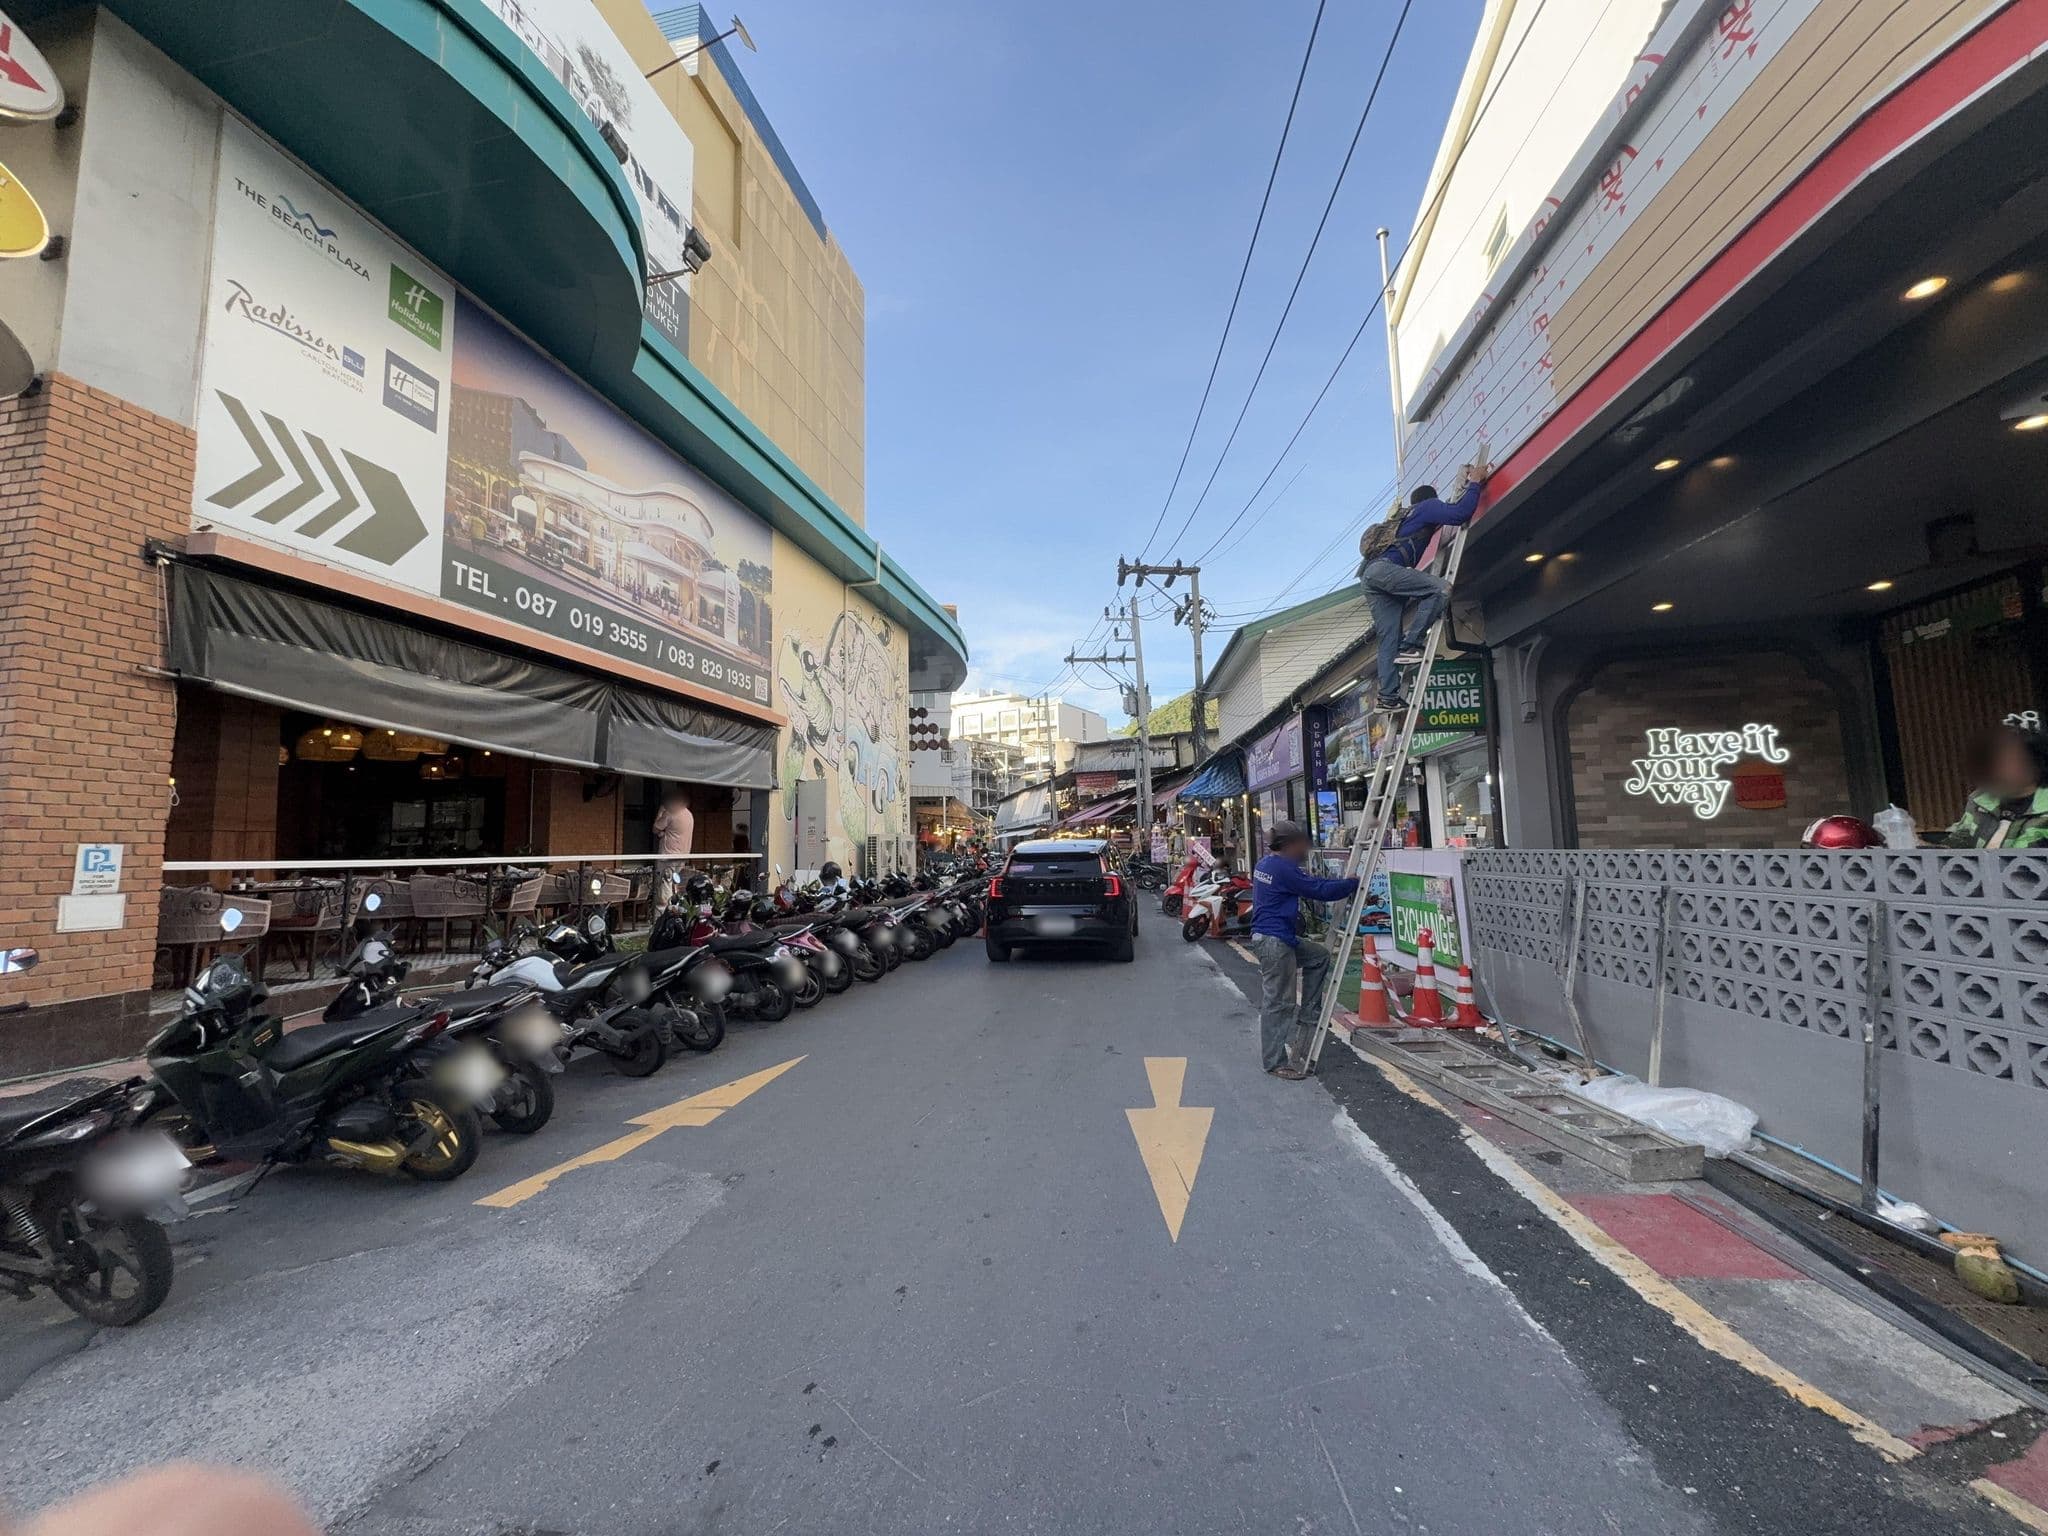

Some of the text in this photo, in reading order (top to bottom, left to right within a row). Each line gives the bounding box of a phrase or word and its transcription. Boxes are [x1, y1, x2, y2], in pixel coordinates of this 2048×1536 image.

[235, 177, 370, 281] THE BEACH PLAZA
[225, 279, 340, 361] Radisson
[391, 299, 426, 331] Holiday
[426, 322, 441, 339] Inn
[645, 297, 679, 337] HUKET
[656, 292, 679, 324] WITH
[515, 586, 557, 618] 087
[570, 607, 604, 636] 019
[609, 623, 648, 652] 3555
[668, 645, 695, 670] 083
[701, 658, 723, 680] 829
[727, 668, 752, 690] 1935
[1429, 711, 1479, 726] обмен
[1313, 722, 1322, 767] ОБМЕН
[1646, 723, 1790, 763] Have it
[1625, 753, 1738, 795] your
[1650, 780, 1731, 819] way
